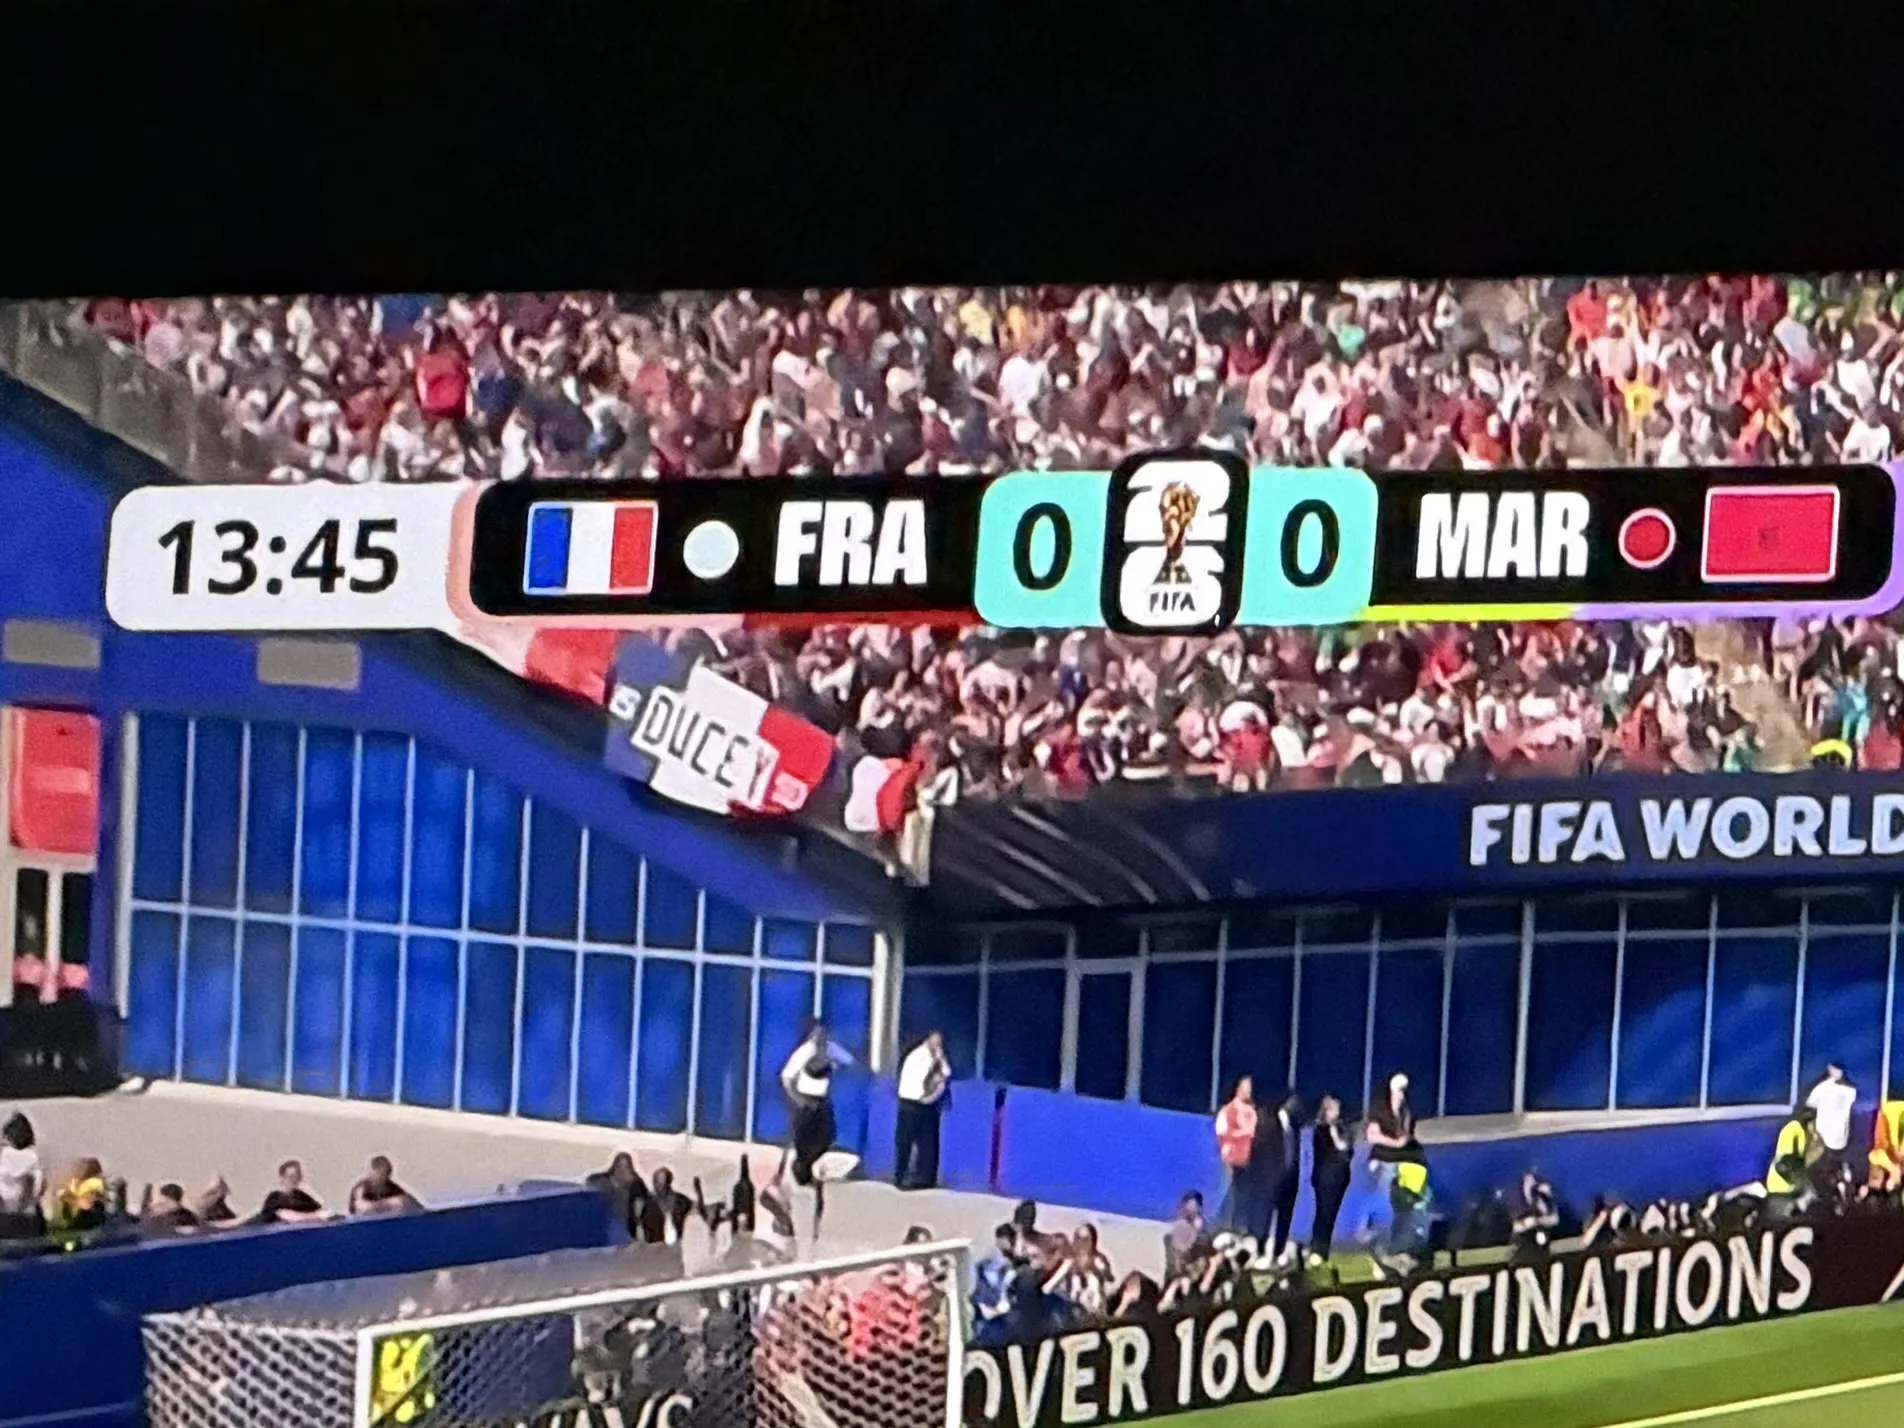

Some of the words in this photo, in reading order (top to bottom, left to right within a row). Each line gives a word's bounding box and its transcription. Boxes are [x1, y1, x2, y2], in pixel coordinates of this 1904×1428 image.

[159, 518, 397, 595] 13:45
[775, 500, 927, 586] FRA
[1014, 502, 1072, 590] 0
[1281, 500, 1340, 587] 0
[1416, 491, 1589, 579] MAR
[1149, 591, 1197, 613] FIFA
[643, 694, 772, 805] DUCEY
[1470, 801, 1625, 866] FIFA
[1175, 1302, 1288, 1405] 160
[1311, 1225, 1814, 1384] DESTINATIONS
